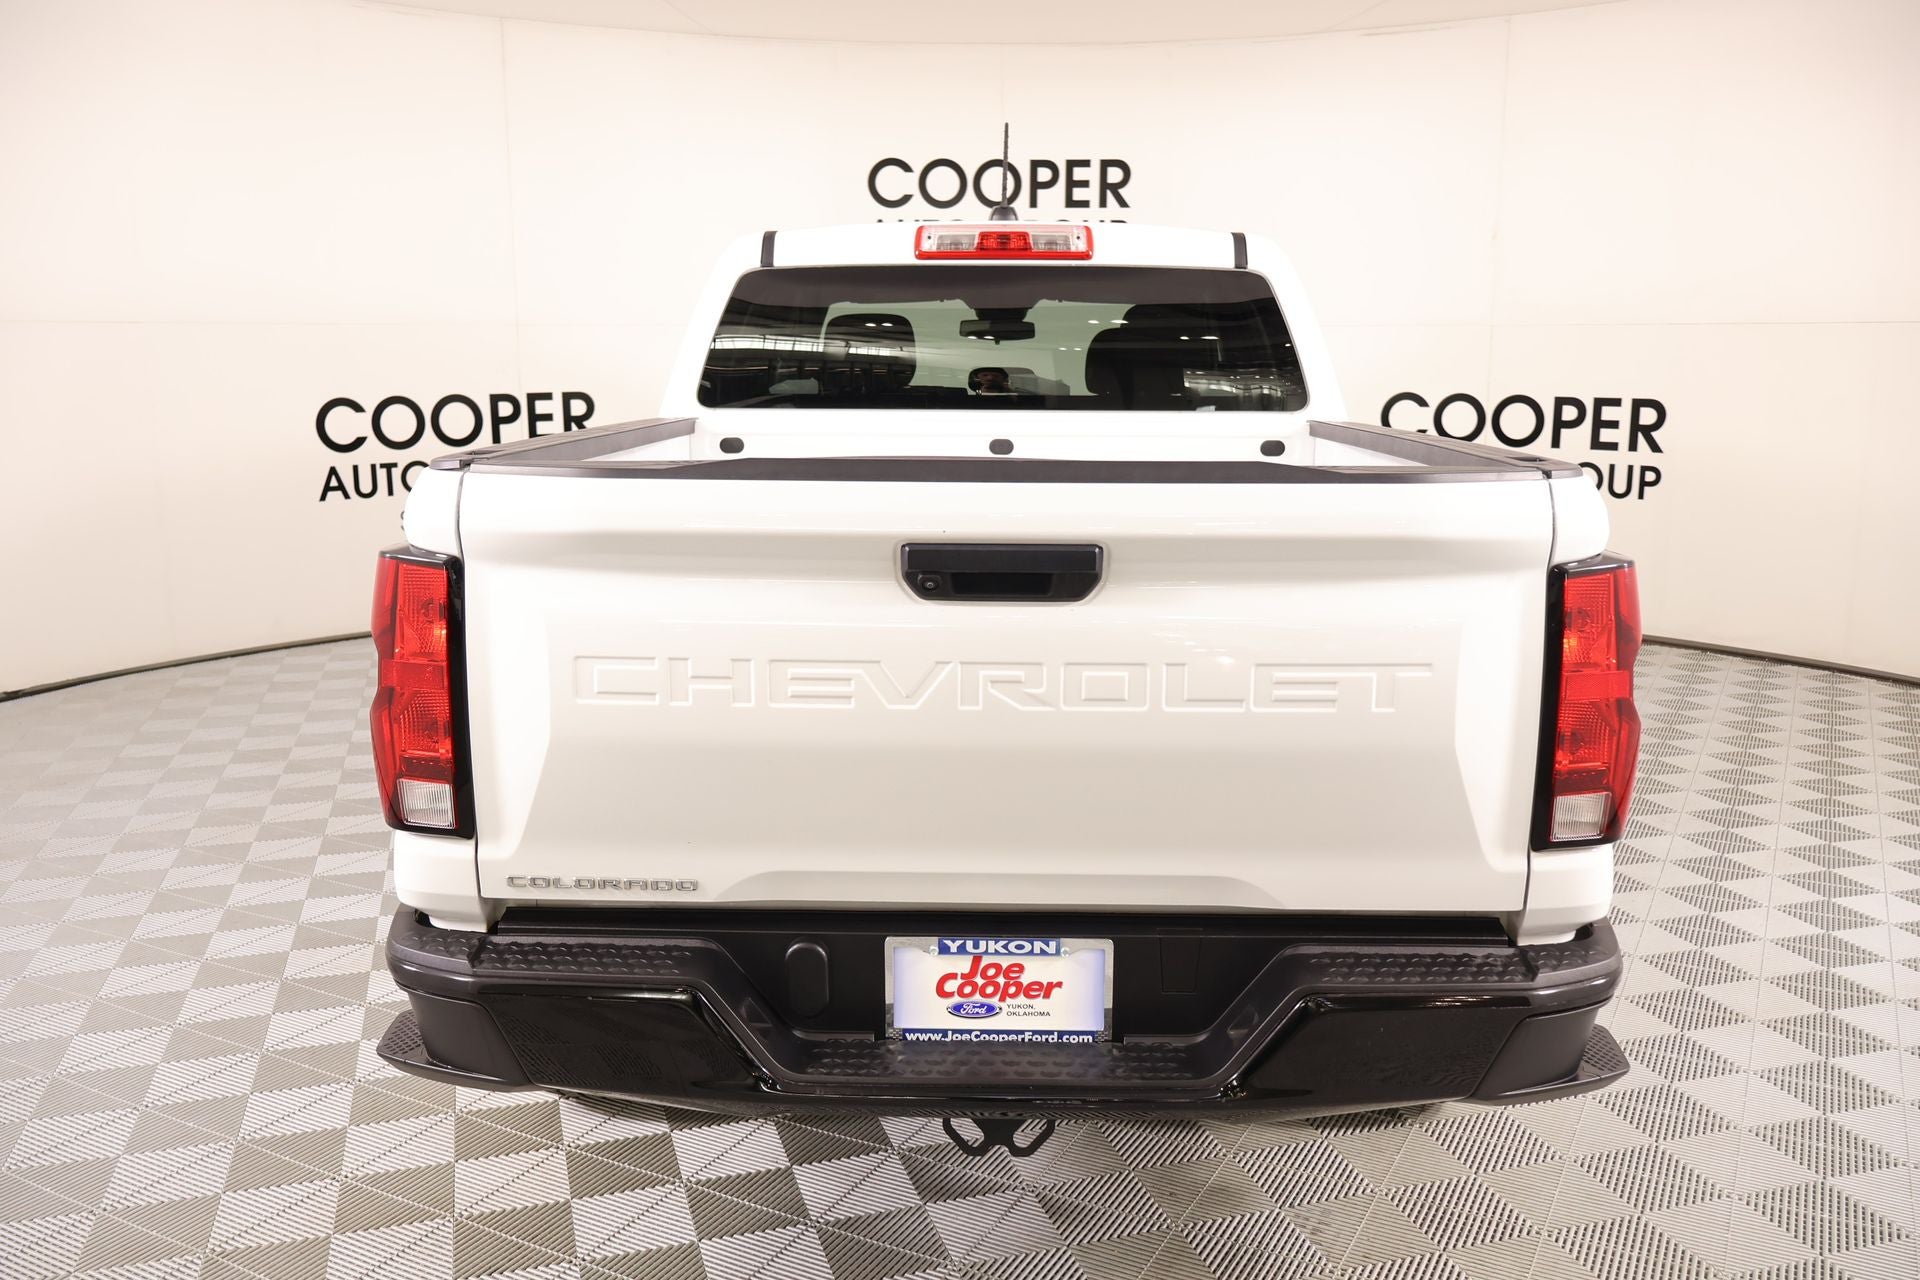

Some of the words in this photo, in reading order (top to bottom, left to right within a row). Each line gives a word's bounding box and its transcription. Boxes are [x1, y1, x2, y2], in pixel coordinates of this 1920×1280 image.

[868, 157, 1131, 209] COOPER
[316, 391, 596, 453] COOPER
[1380, 391, 1667, 454] COOPER
[573, 655, 1433, 713] CHEVROLET
[506, 875, 699, 892] COLORADO
[942, 939, 1056, 954] YUKON
[960, 955, 1025, 981] Joe
[935, 972, 1063, 1002] Cooper
[960, 1003, 988, 1015] Ford
[905, 1031, 1093, 1044] www.JoeCooperFord.com
